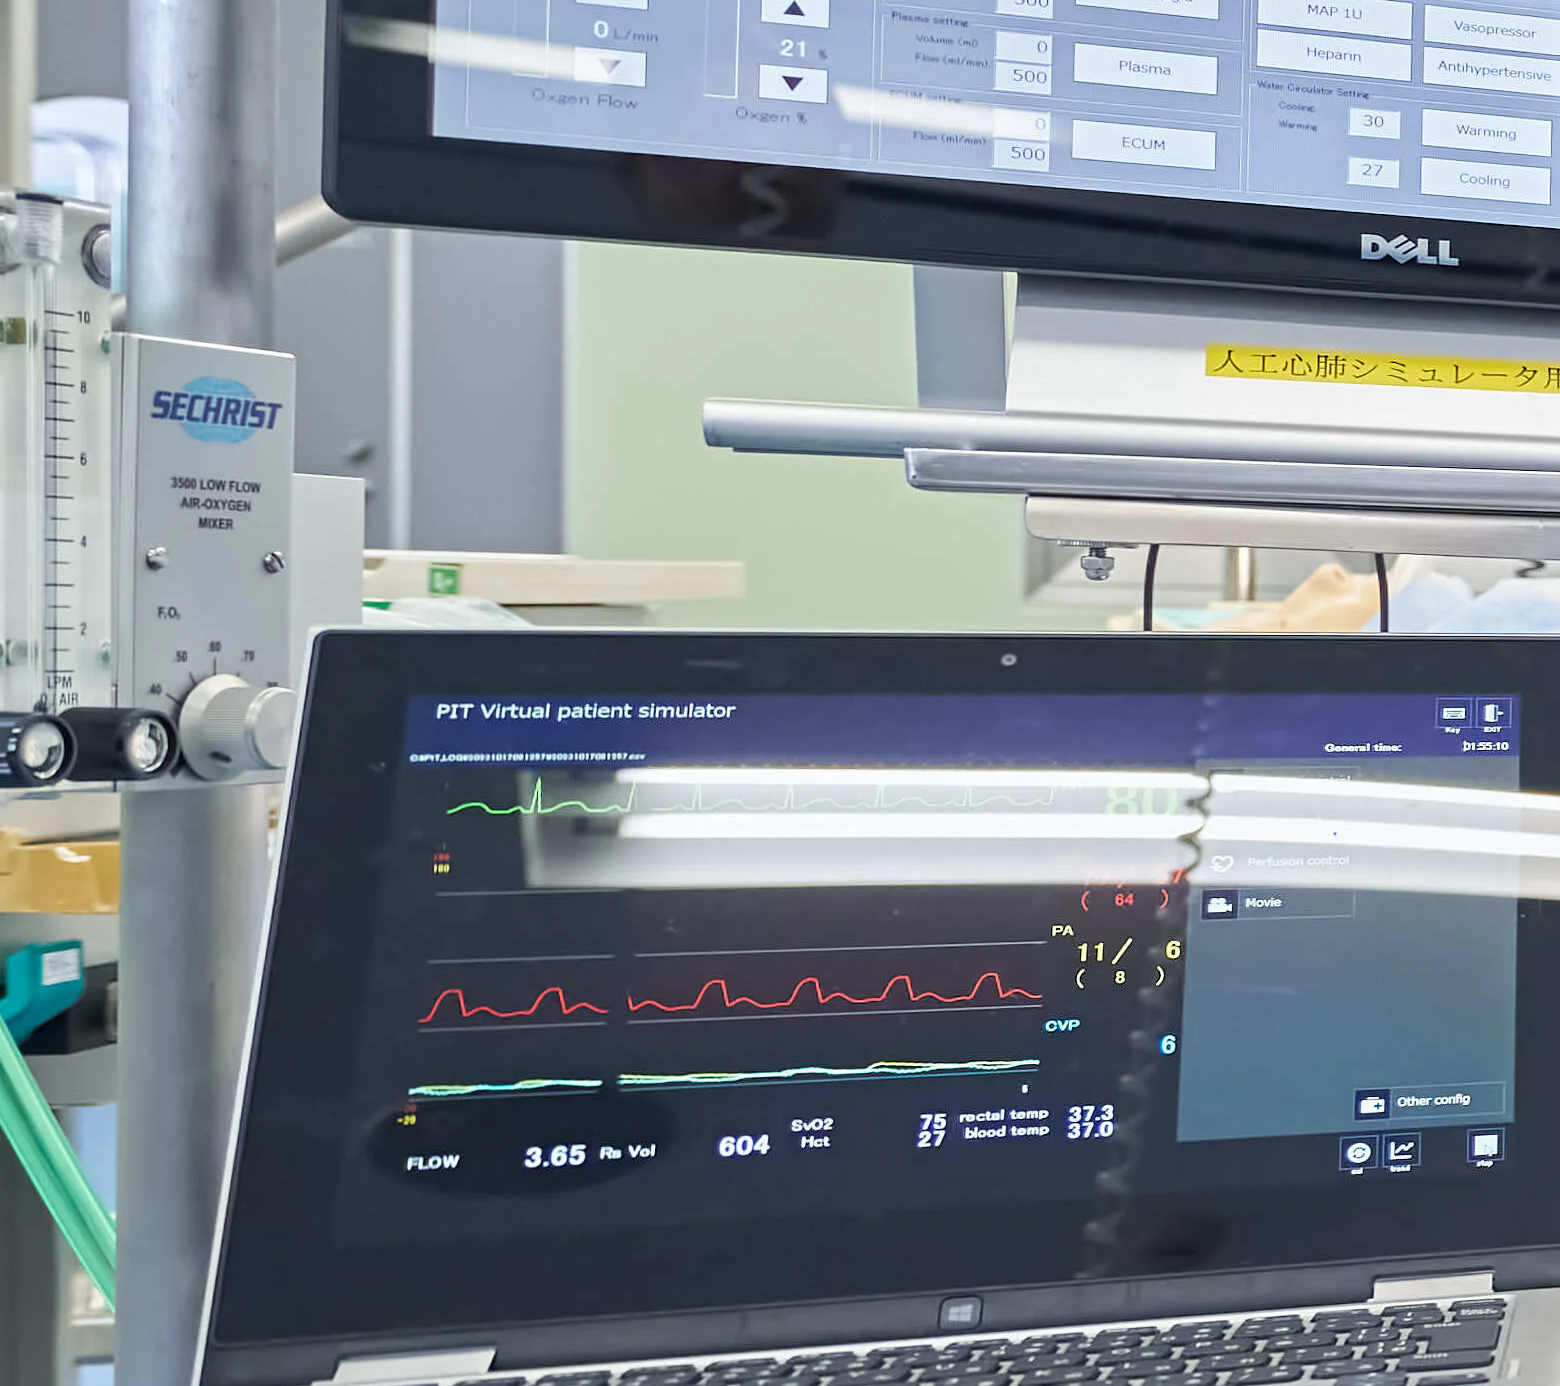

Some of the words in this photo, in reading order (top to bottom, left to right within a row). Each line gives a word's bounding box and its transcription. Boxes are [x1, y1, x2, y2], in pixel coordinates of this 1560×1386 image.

[1307, 3, 1338, 18] MAP
[1343, 5, 1364, 21] 1U
[593, 20, 609, 39] 0
[613, 27, 659, 43] L/min
[1454, 20, 1537, 40] Vasopressor
[780, 39, 807, 58] 21
[1306, 46, 1362, 64] Heparin
[1118, 60, 1172, 76] Plasma
[1438, 60, 1552, 82] Antihypertensive
[1012, 68, 1048, 85] 500
[531, 87, 590, 107] Oxgen
[597, 93, 640, 110] Flow
[735, 106, 790, 124] Oxgen
[1363, 114, 1384, 128] 30
[1456, 124, 1517, 142] Warming
[1121, 136, 1166, 151] ECUM
[1010, 146, 1046, 162] 500
[1361, 164, 1383, 178] 27
[1459, 172, 1511, 190] Cooling
[1361, 233, 1460, 266] DELL
[77, 310, 91, 324] 10
[80, 381, 87, 394] 8
[151, 390, 283, 430] SECHRIST
[80, 452, 88, 466] 6
[170, 476, 197, 490] 3500
[199, 479, 227, 492] LOW
[229, 480, 262, 494] FLOW
[180, 496, 252, 512] AIR-OXYGEN
[197, 516, 234, 530] MIXER
[80, 535, 87, 548] 4
[80, 623, 87, 636] 2
[47, 675, 72, 689] LPM
[59, 692, 79, 706] AIR
[436, 702, 474, 720] PIT
[480, 702, 551, 720] Virtual
[557, 702, 633, 722] patient
[638, 702, 737, 719] simulator
[1324, 741, 1371, 753] General
[1373, 742, 1403, 753] time:
[1463, 740, 1509, 752] 01:55:10
[1248, 856, 1304, 868] Perfusion
[1306, 855, 1350, 867] control
[1114, 893, 1134, 907] 64
[1245, 896, 1282, 909] Movie
[1051, 924, 1075, 937] PA
[1077, 942, 1105, 962] 11
[1165, 940, 1181, 959] 6
[1045, 1018, 1081, 1032] CVP
[1161, 1034, 1177, 1055] 6
[1397, 1095, 1433, 1108] Other
[1434, 1093, 1471, 1107] config
[920, 1113, 947, 1131] 75
[959, 1108, 1005, 1124] rectal
[1009, 1107, 1050, 1123] temp
[1068, 1104, 1115, 1123] 37.3
[964, 1125, 1007, 1140] blood
[1011, 1123, 1050, 1138] temp
[1066, 1121, 1114, 1139] 37.0
[800, 1135, 831, 1149] Hct
[917, 1130, 947, 1148] 27
[407, 1154, 460, 1171] FLOW
[524, 1144, 587, 1169] 3.65
[628, 1143, 656, 1158] Vol
[718, 1134, 771, 1158] 604
